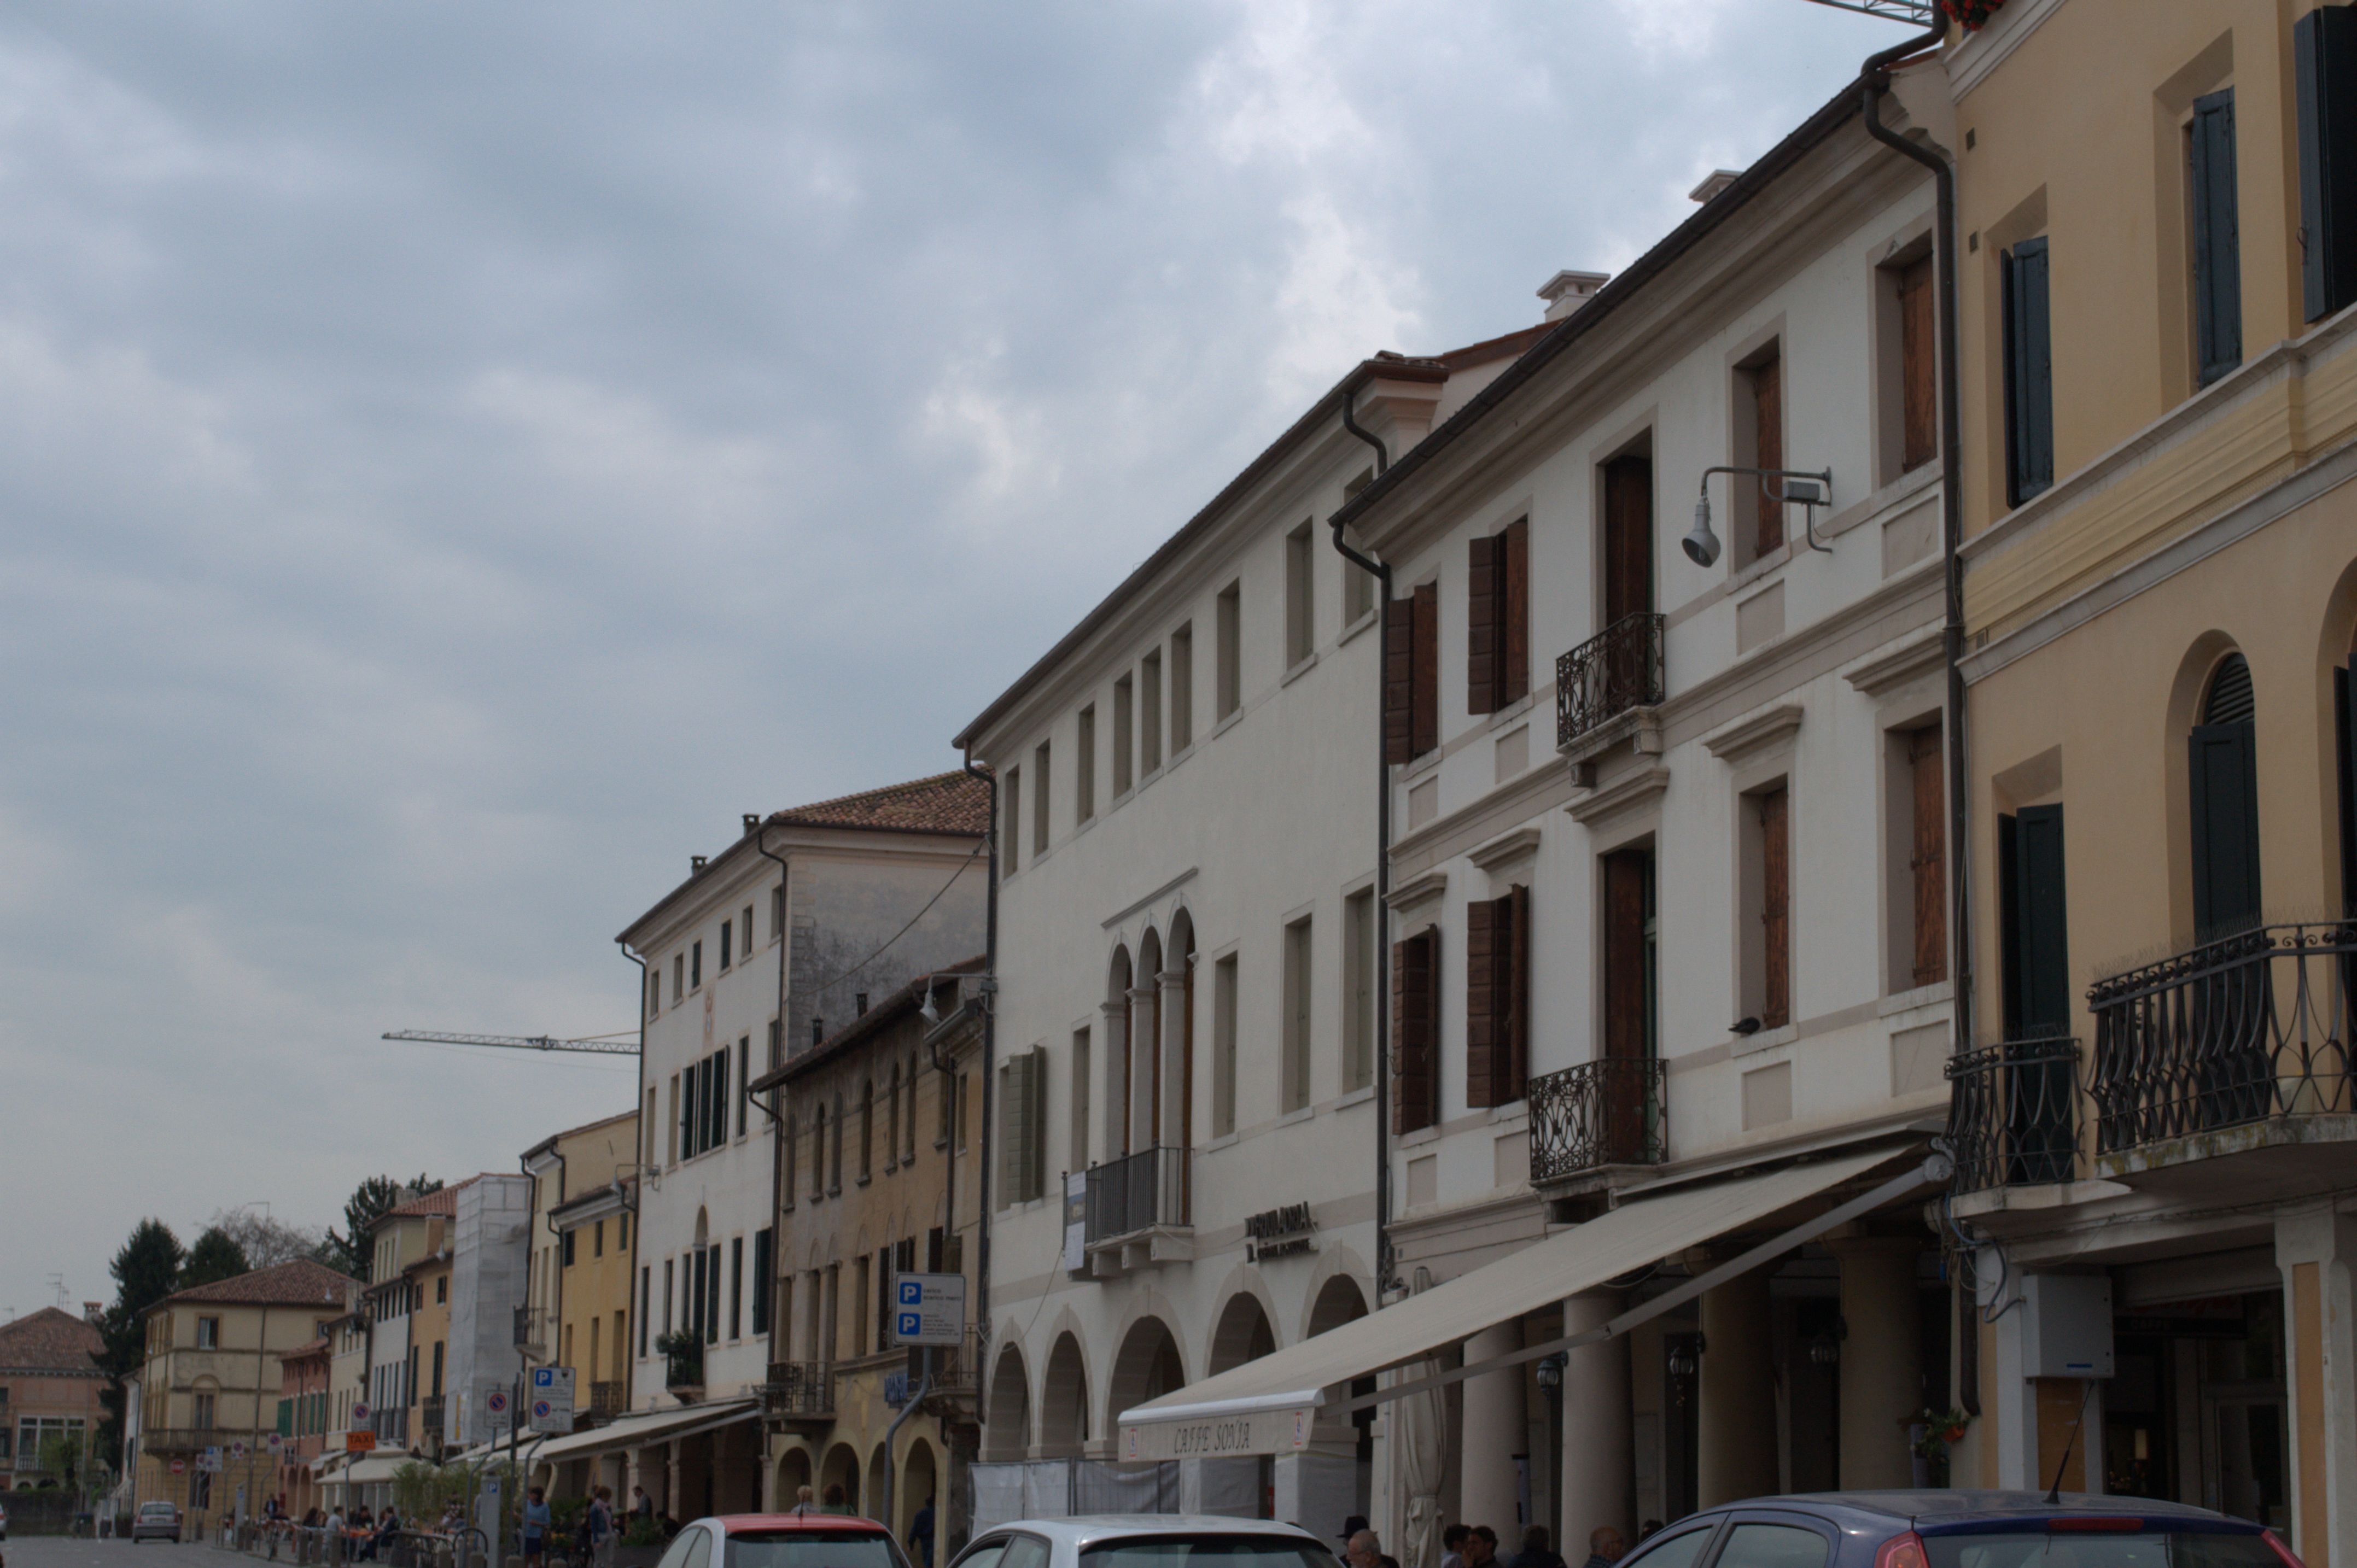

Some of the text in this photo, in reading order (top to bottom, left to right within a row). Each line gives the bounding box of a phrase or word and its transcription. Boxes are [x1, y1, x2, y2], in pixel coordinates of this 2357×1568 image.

[904, 1285, 917, 1301] P
[903, 1316, 915, 1332] P
[539, 1372, 549, 1384] P
[349, 1435, 374, 1444] TAXI
